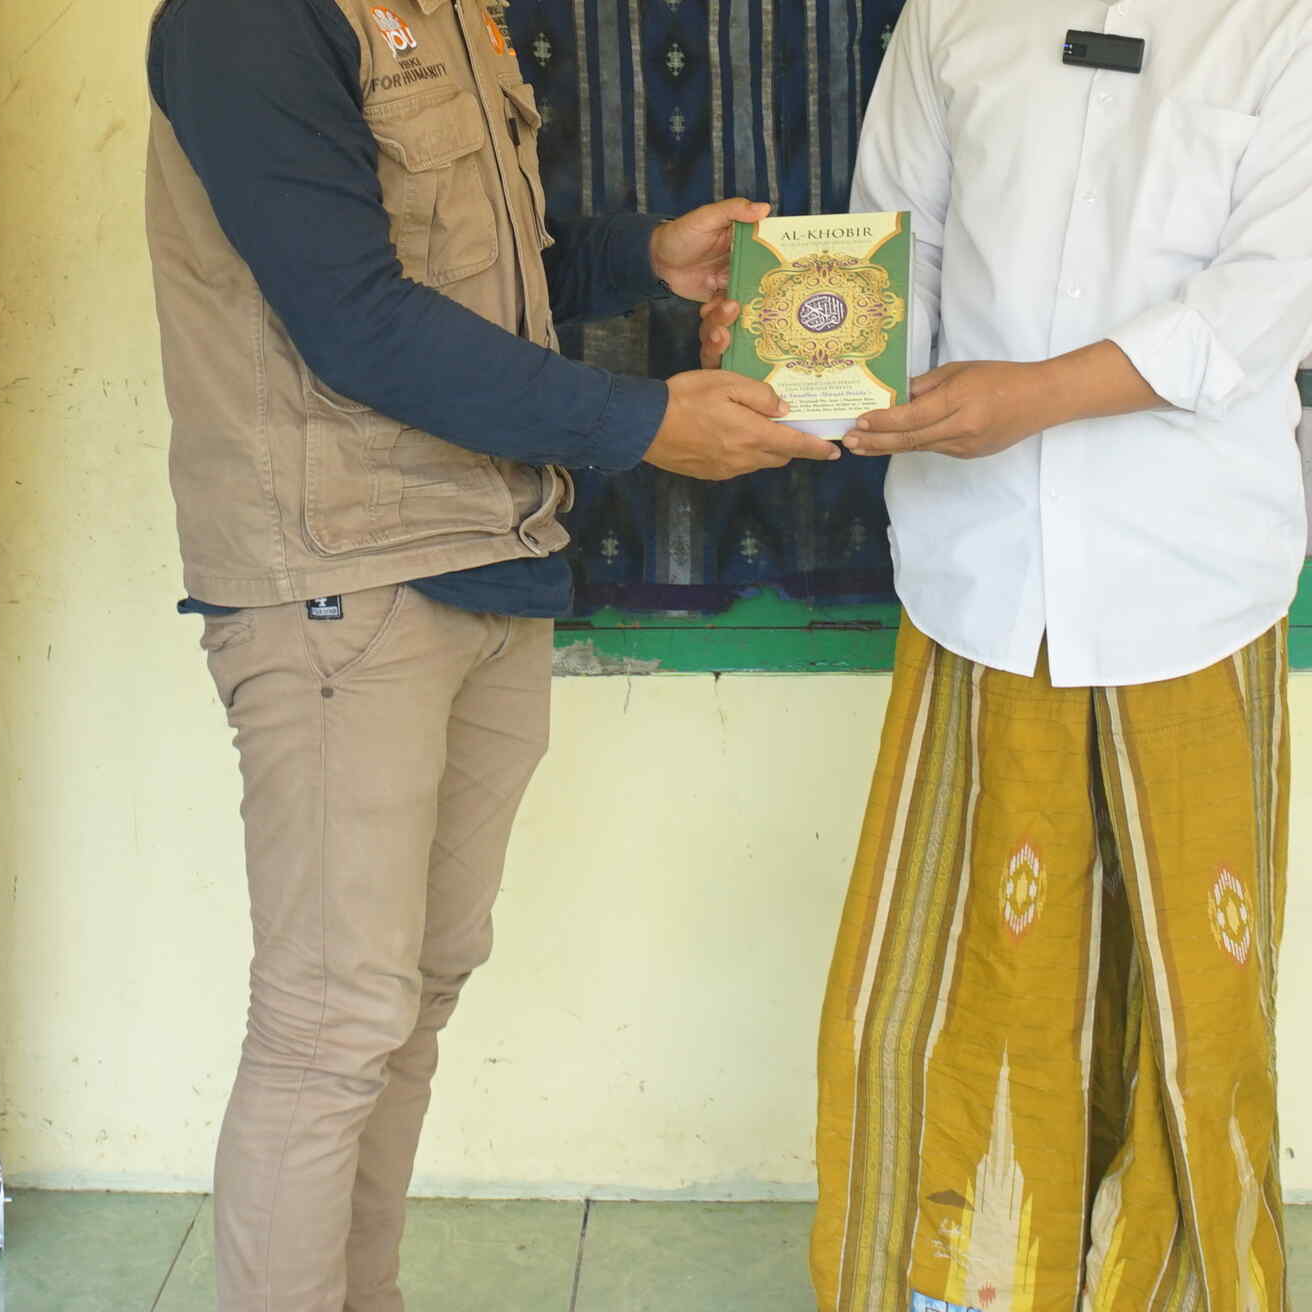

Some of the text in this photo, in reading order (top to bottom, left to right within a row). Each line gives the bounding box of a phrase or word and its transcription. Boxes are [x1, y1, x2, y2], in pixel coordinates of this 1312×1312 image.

[371, 63, 448, 92] FOR HUMANITY
[781, 226, 873, 242] AL-KHOBIR
